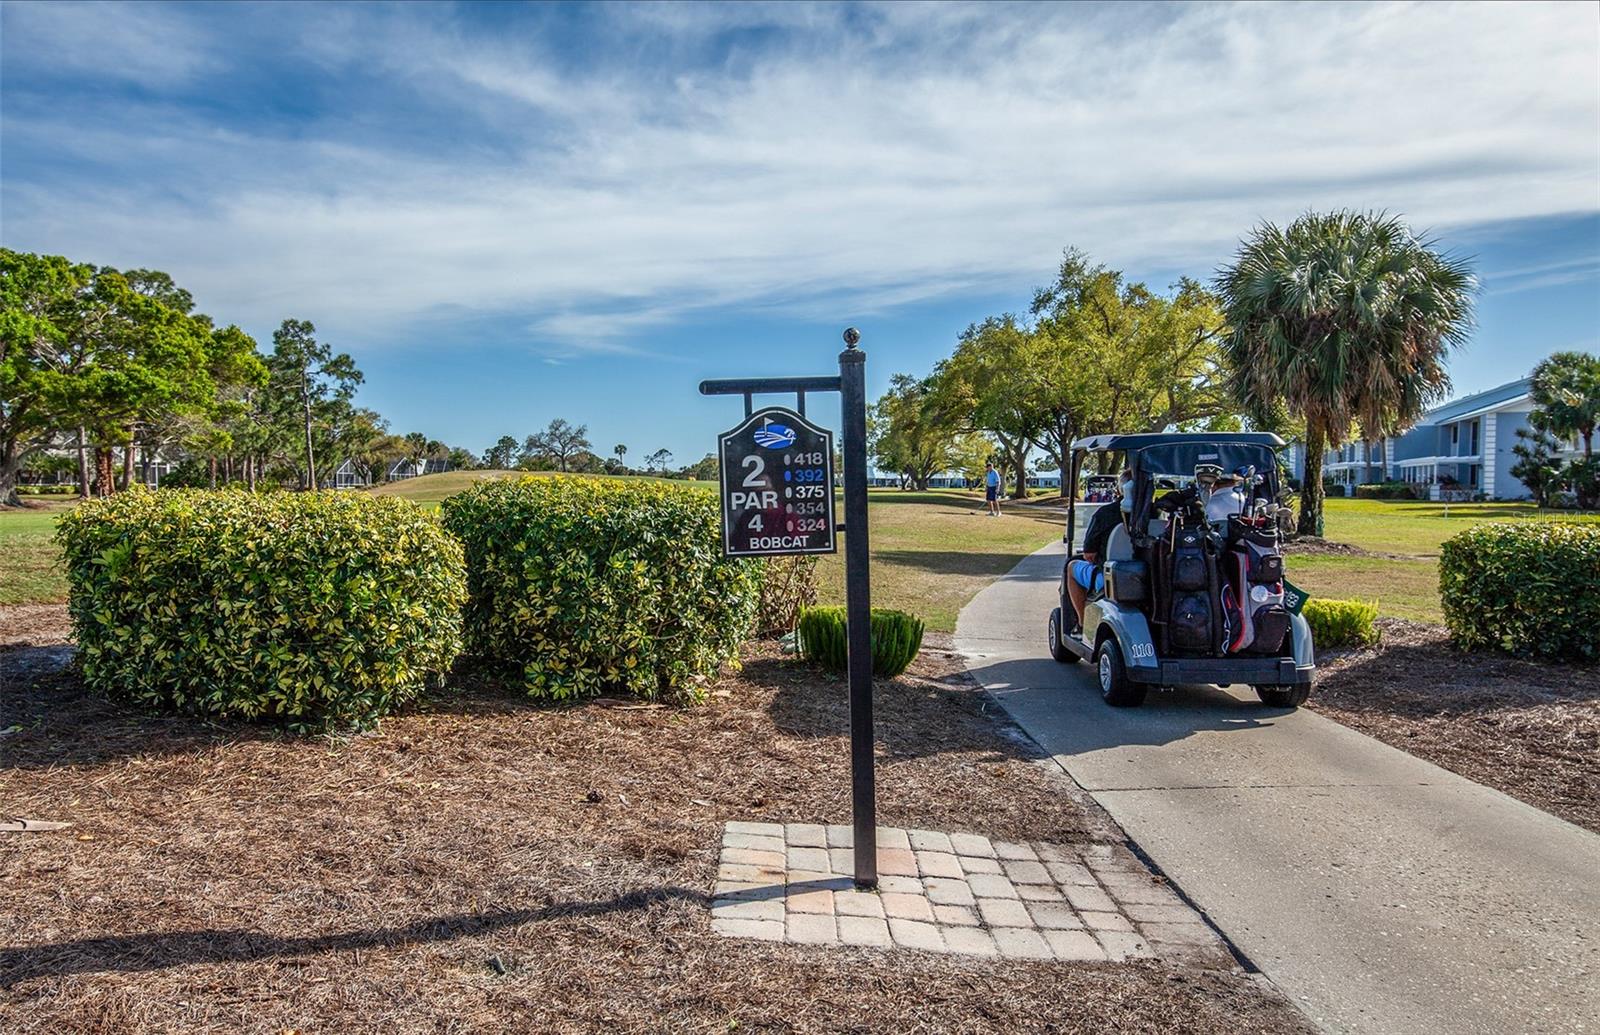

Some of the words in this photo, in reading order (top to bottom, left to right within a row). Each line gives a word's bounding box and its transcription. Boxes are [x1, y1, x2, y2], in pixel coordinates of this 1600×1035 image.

[794, 452, 823, 465] 418
[741, 455, 766, 487] 2
[795, 469, 824, 482] 392
[795, 485, 825, 498] 375
[731, 491, 778, 510] PAR
[796, 502, 825, 515] 354
[748, 514, 764, 532] 4
[797, 518, 826, 532] 324
[749, 535, 810, 549] BOBCAT
[1131, 643, 1155, 659] 110
